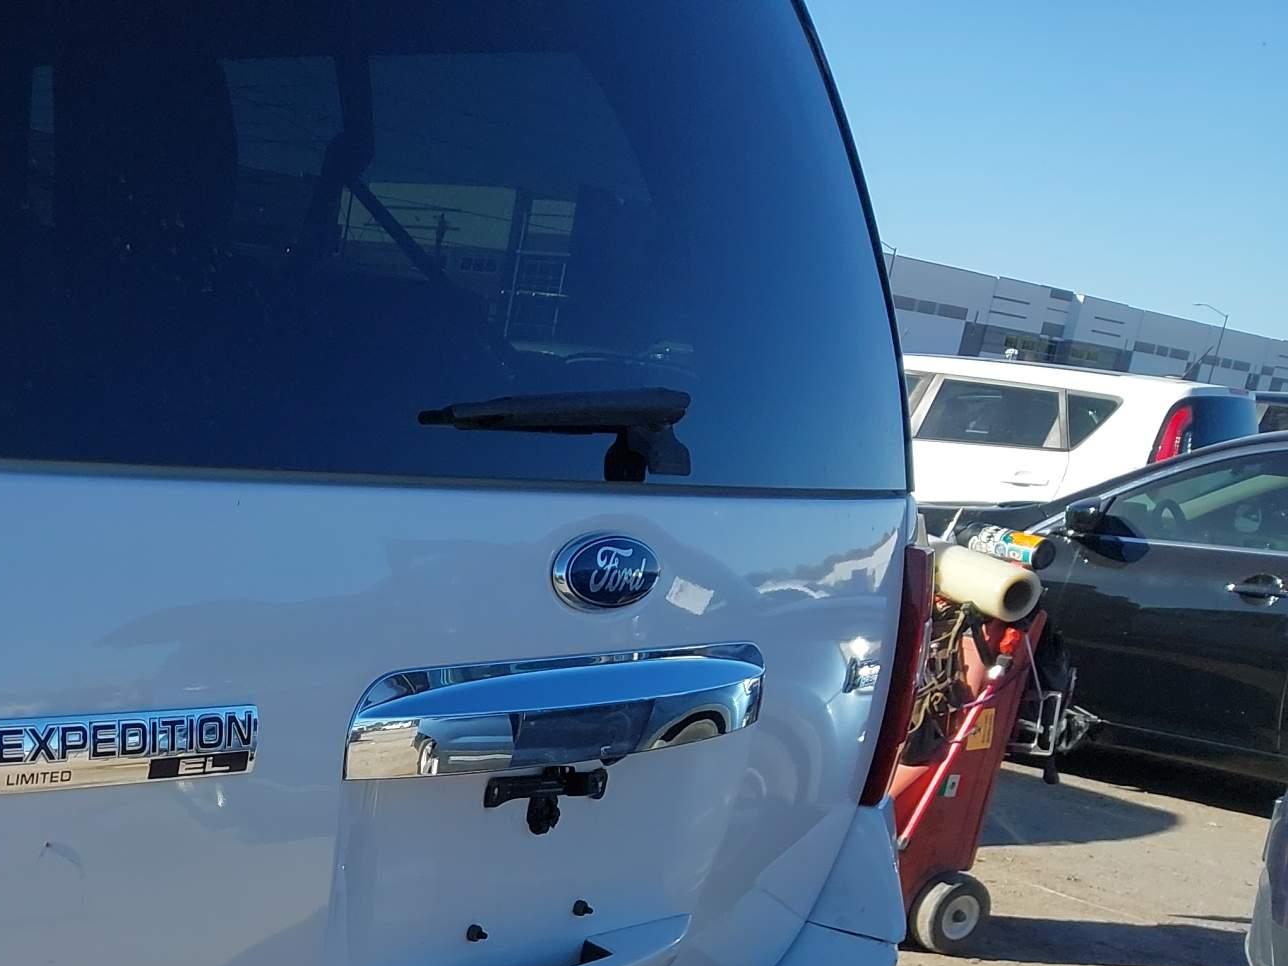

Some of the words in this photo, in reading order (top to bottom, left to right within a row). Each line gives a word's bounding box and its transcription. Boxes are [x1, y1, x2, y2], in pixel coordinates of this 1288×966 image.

[589, 546, 646, 592] Ford
[177, 756, 230, 776] EL
[6, 769, 72, 787] LIMITED
